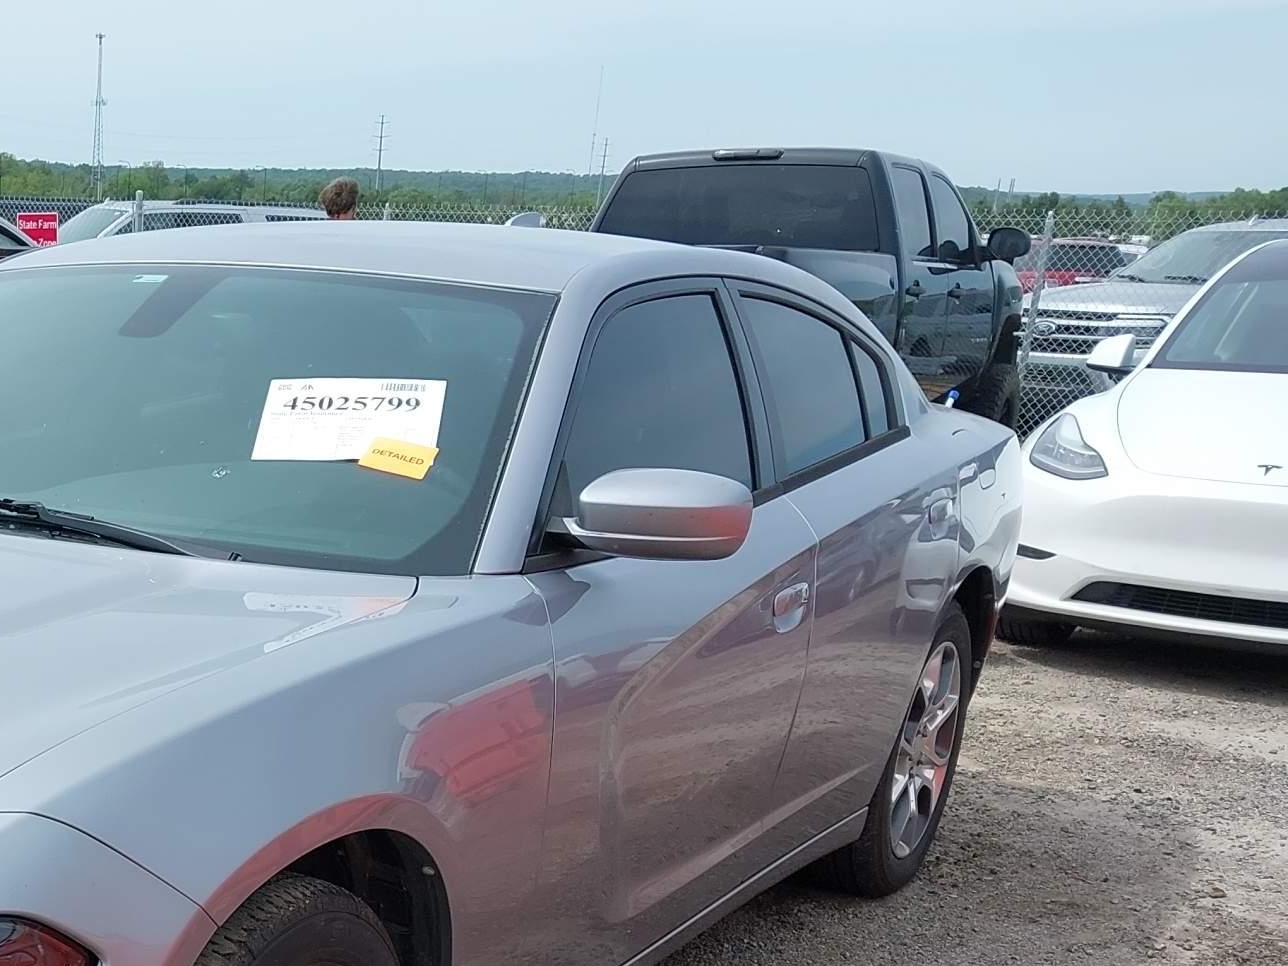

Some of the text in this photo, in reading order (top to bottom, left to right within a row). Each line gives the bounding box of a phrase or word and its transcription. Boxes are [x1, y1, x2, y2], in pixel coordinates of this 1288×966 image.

[19, 220, 57, 230] State Farm
[283, 396, 421, 412] 45025799
[371, 448, 425, 466] DETAILED
